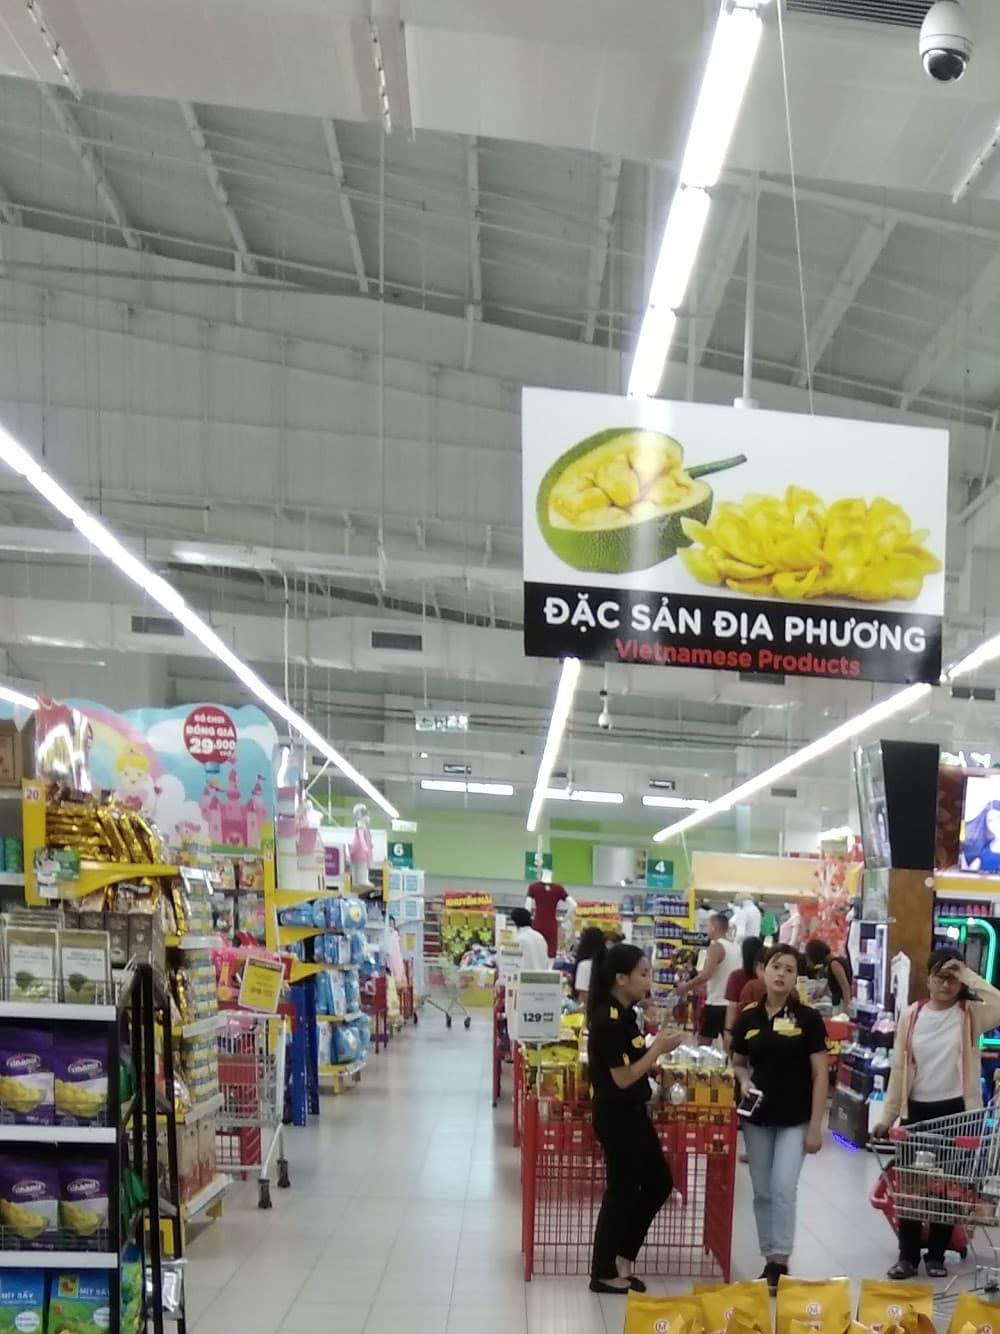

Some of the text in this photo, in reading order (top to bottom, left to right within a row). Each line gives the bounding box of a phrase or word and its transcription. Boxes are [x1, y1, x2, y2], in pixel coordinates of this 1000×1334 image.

[544, 593, 926, 653] ĐẶC SẢN ĐỊA PHƯƠNG
[616, 638, 860, 676] Vietnamese Products
[393, 844, 404, 855] 6
[655, 861, 666, 873] 4
[523, 1013, 542, 1022] 129
